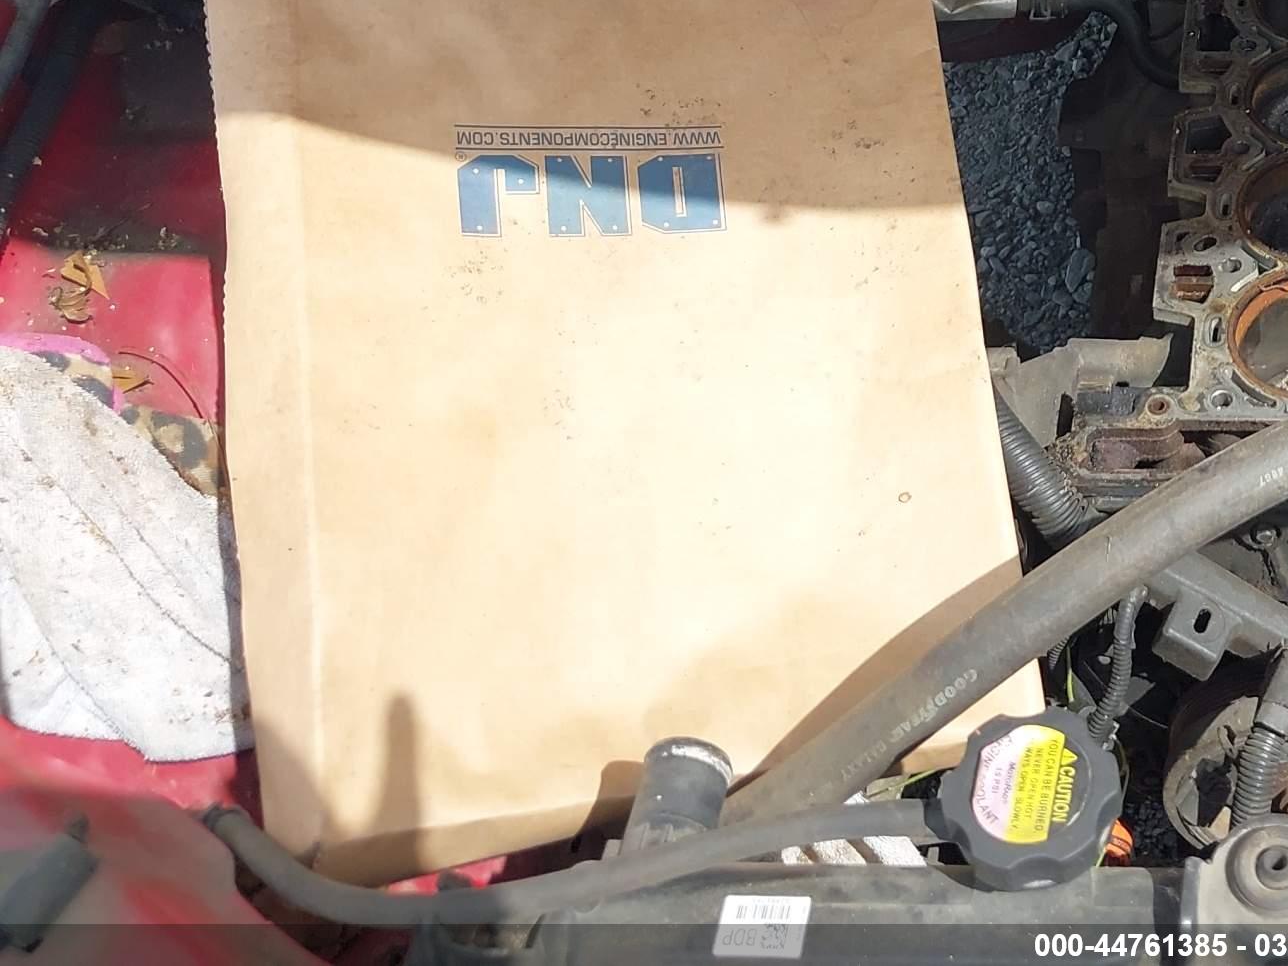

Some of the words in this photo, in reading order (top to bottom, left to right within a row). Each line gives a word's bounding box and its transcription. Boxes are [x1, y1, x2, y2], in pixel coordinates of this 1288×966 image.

[456, 129, 722, 147] WWW.ENGINECOMPONENTS.COM
[455, 151, 727, 237] DNJ
[1047, 739, 1059, 757] YOU
[1032, 748, 1044, 774] NEVER
[1044, 757, 1055, 777] CAN
[1017, 771, 1028, 792] OPEN
[1027, 777, 1039, 800] OPEN
[1042, 779, 1052, 791] BE
[1051, 765, 1076, 822] CAUTION
